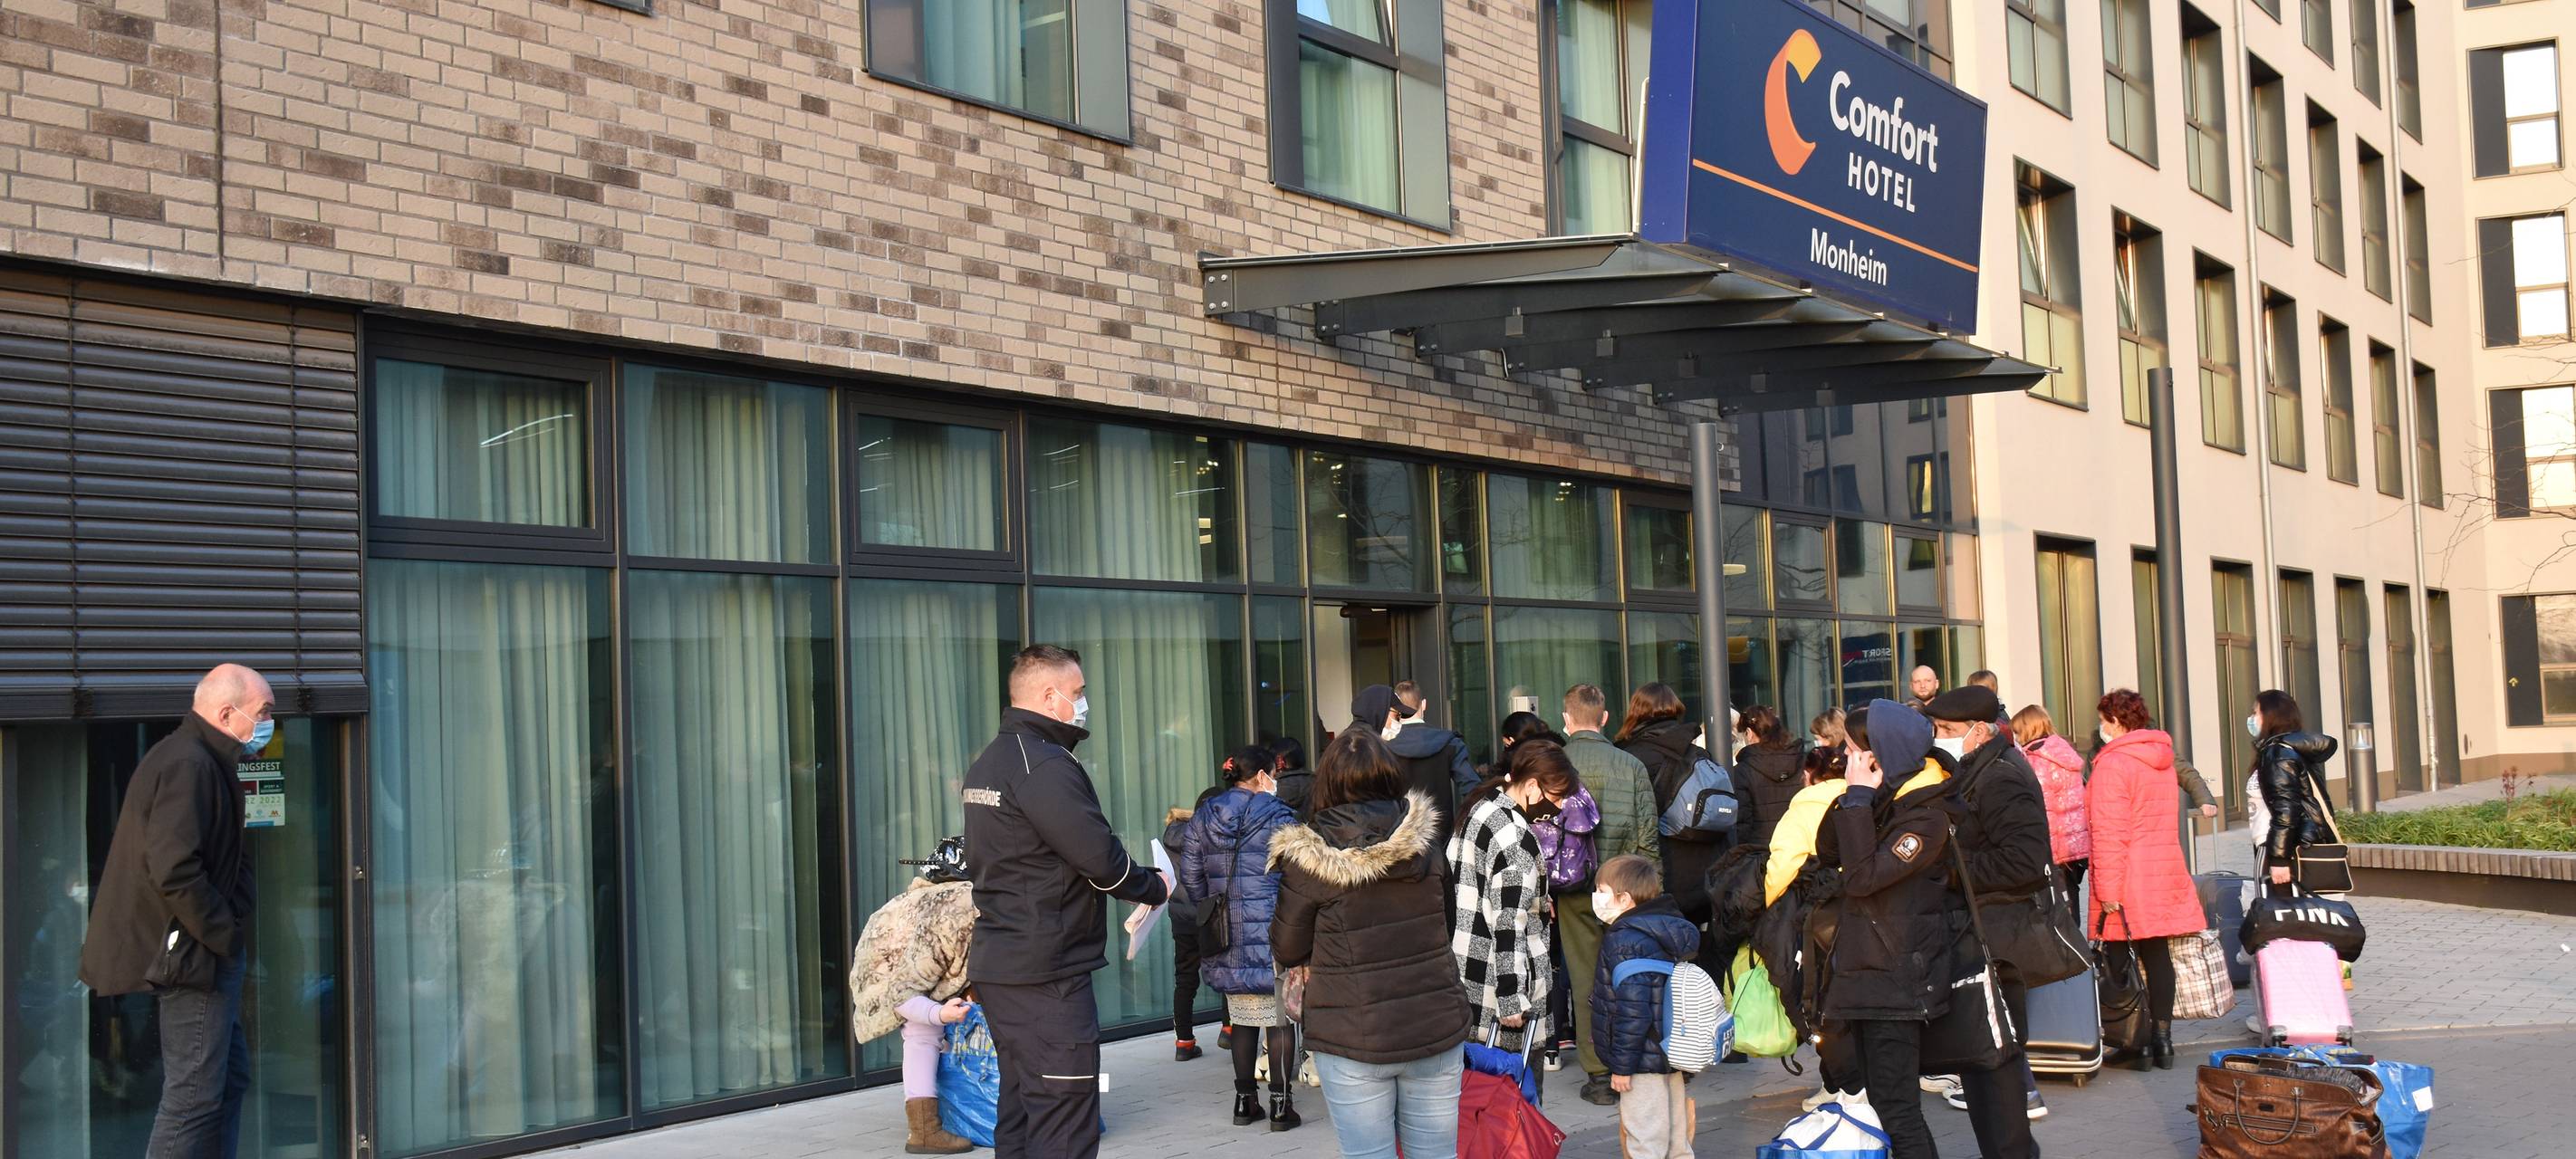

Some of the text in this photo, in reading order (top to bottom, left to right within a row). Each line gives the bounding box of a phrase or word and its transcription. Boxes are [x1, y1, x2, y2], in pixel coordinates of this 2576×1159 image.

[1830, 71, 1938, 172] Comfort
[1848, 152, 1916, 213] HOTEL
[1811, 228, 1887, 285] Monheim
[237, 762, 280, 771] INGSFEST
[260, 796, 281, 804] 2022
